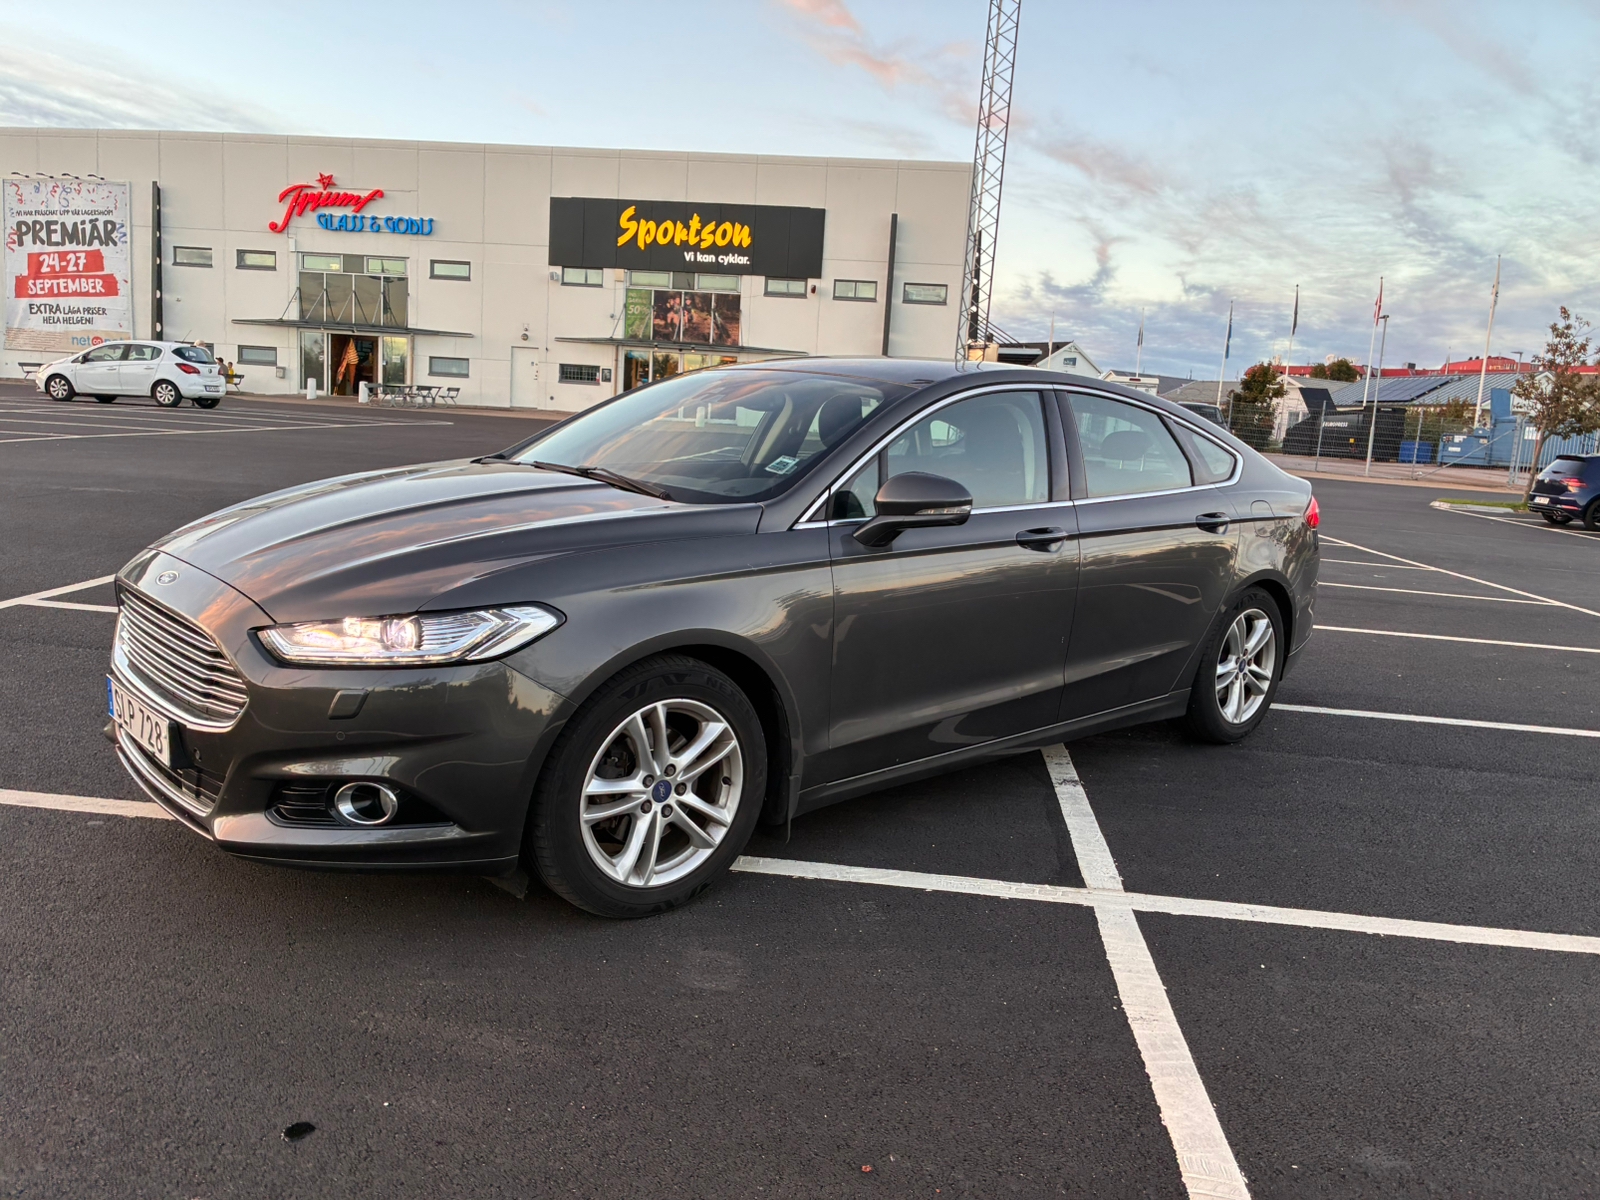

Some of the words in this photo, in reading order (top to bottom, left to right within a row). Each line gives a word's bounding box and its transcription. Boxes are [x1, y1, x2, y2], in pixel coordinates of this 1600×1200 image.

[269, 183, 384, 233] Triumf
[316, 213, 365, 232] GLASS
[369, 215, 380, 233] &
[384, 216, 434, 236] GODIS
[617, 205, 752, 250] Sportson
[39, 253, 86, 273] 24-27
[684, 251, 694, 262] Vi
[696, 252, 716, 263] kan
[717, 253, 750, 265] cyklar.
[28, 278, 105, 294] SEPTEMBER
[29, 303, 61, 315] EXTRA
[63, 305, 82, 315] LÅGA
[43, 316, 61, 325] HELA
[62, 316, 93, 325] HELGEN!
[114, 688, 135, 730] SLP
[139, 708, 163, 754] 728
